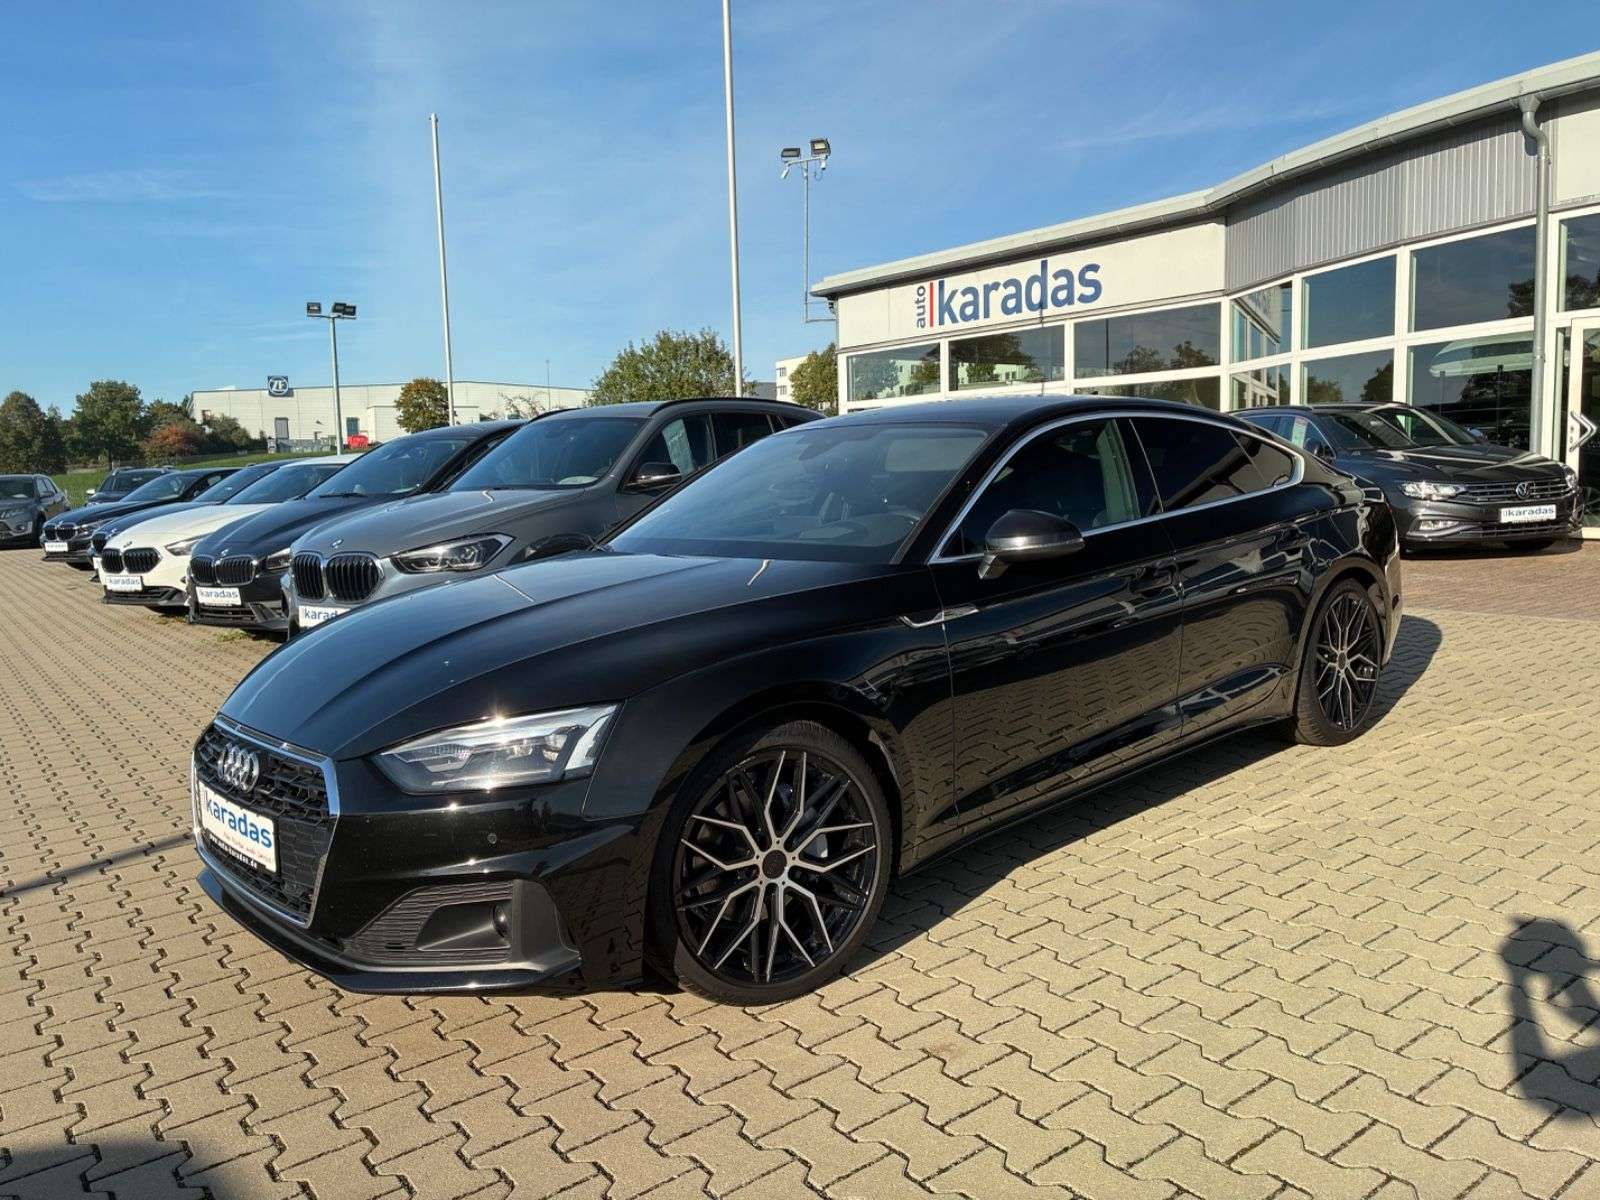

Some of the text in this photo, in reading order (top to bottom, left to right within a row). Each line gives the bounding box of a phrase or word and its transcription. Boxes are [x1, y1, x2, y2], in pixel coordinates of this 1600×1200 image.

[915, 284, 926, 329] auto
[938, 259, 1103, 326] karadas
[1508, 507, 1554, 517] karadas
[199, 590, 239, 599] karadas
[206, 799, 273, 849] karadas
